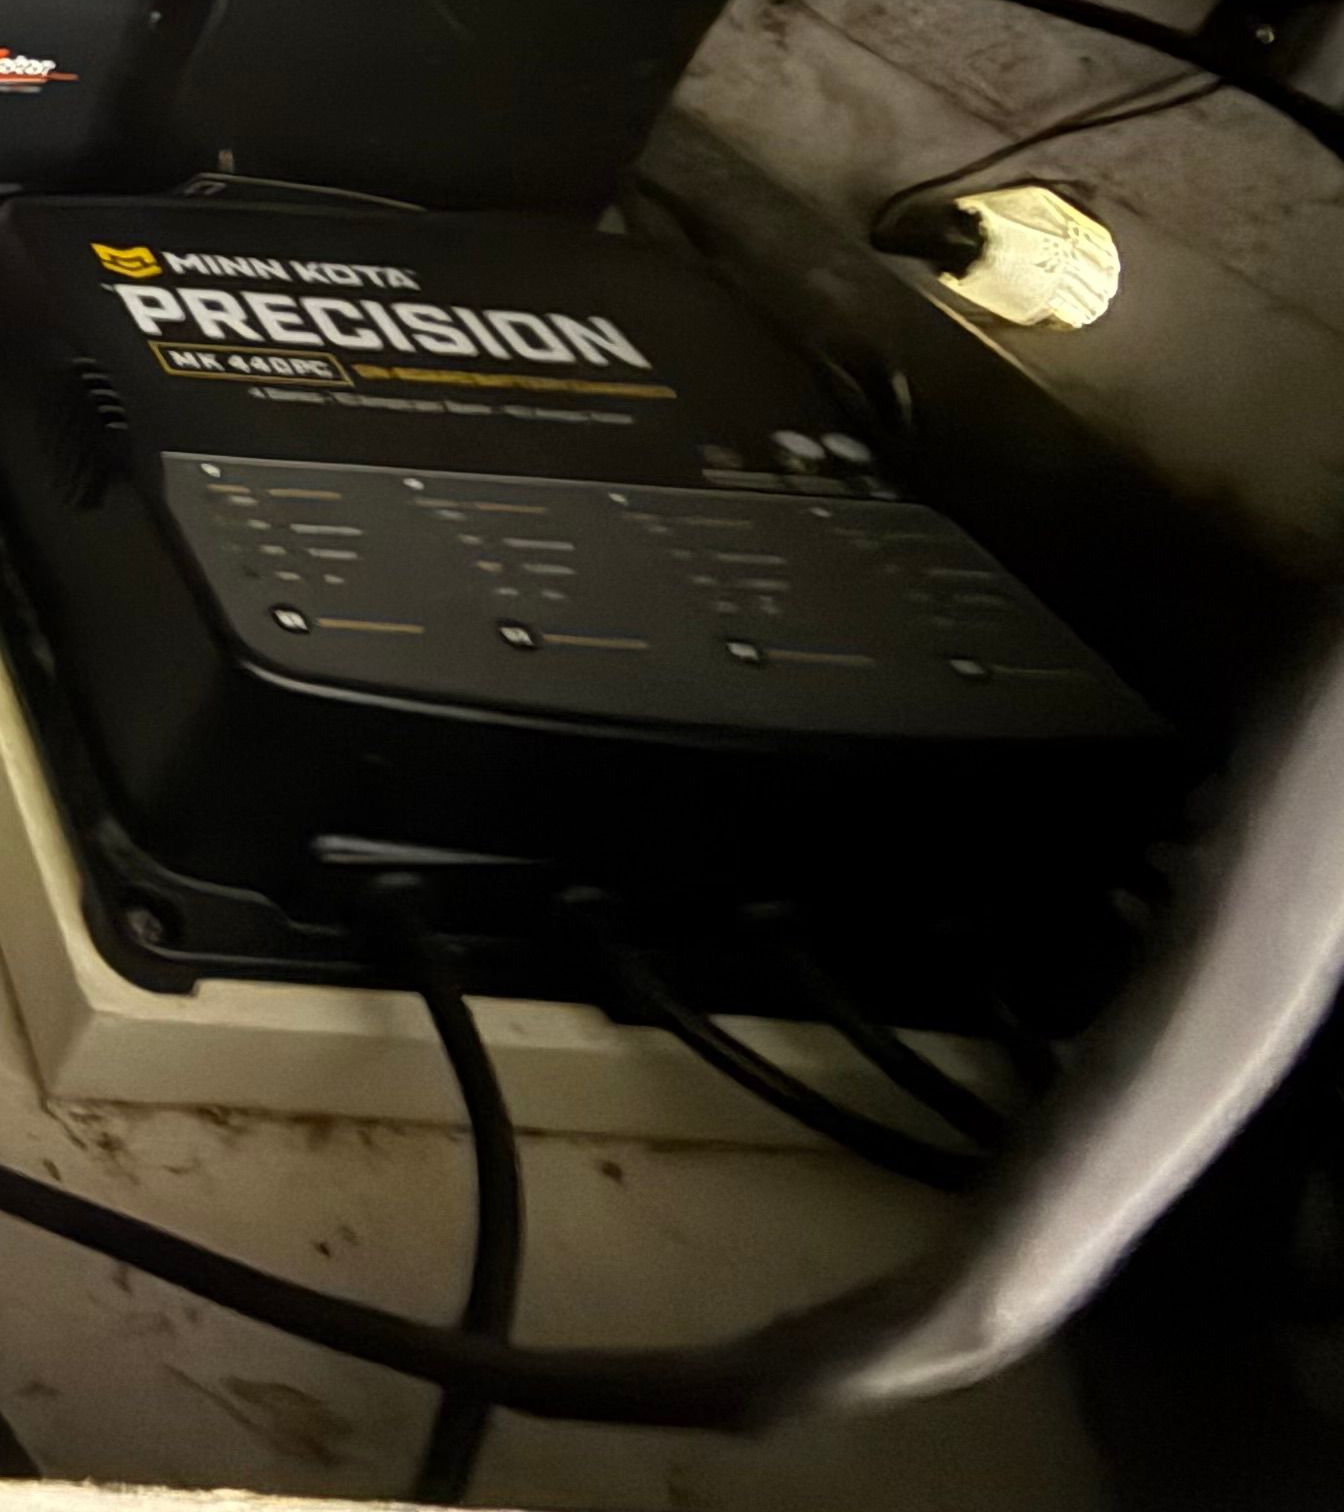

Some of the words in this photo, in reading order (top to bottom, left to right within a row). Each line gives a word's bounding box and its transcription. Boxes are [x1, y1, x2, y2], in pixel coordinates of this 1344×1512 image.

[162, 251, 296, 282] MINN
[298, 258, 422, 292] KOTA
[114, 283, 654, 371] PRECISION
[167, 350, 226, 372] MK
